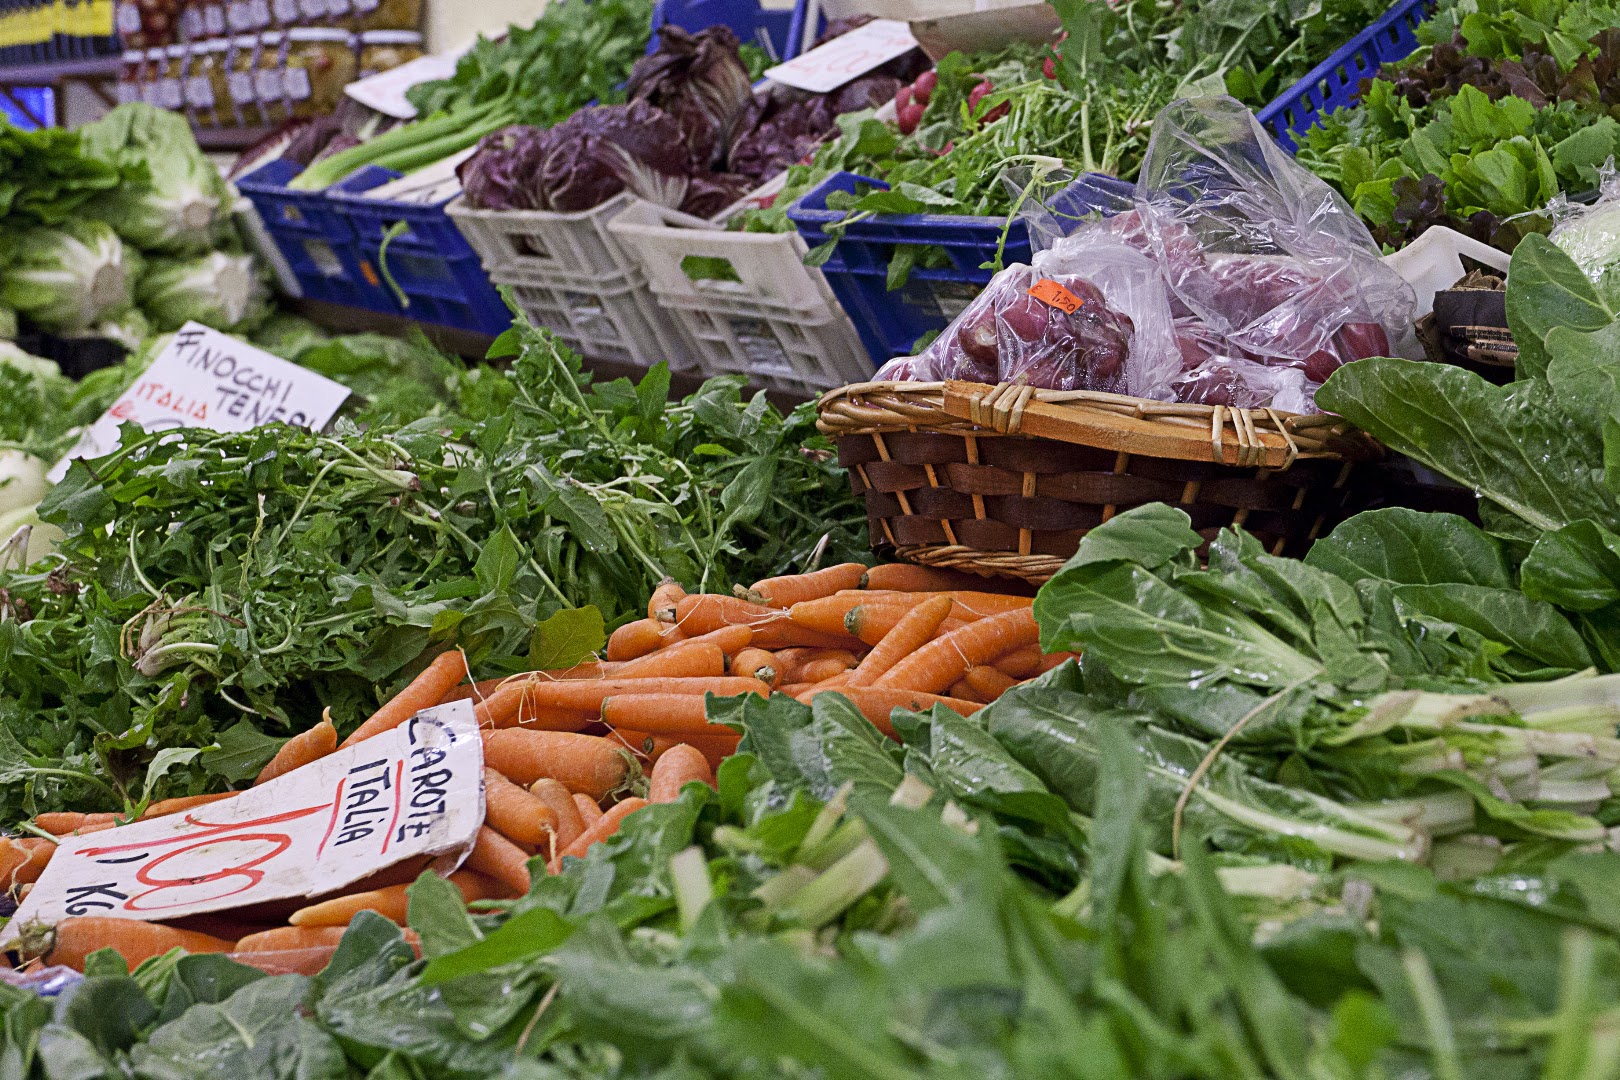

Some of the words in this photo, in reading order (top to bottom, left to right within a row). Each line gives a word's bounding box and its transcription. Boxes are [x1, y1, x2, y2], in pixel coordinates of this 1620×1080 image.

[1051, 290, 1076, 312] 1,50
[175, 329, 294, 404] FINOCCHI
[135, 383, 208, 420] ITALIA
[395, 715, 457, 843] CAROTE
[65, 882, 129, 916] KG
